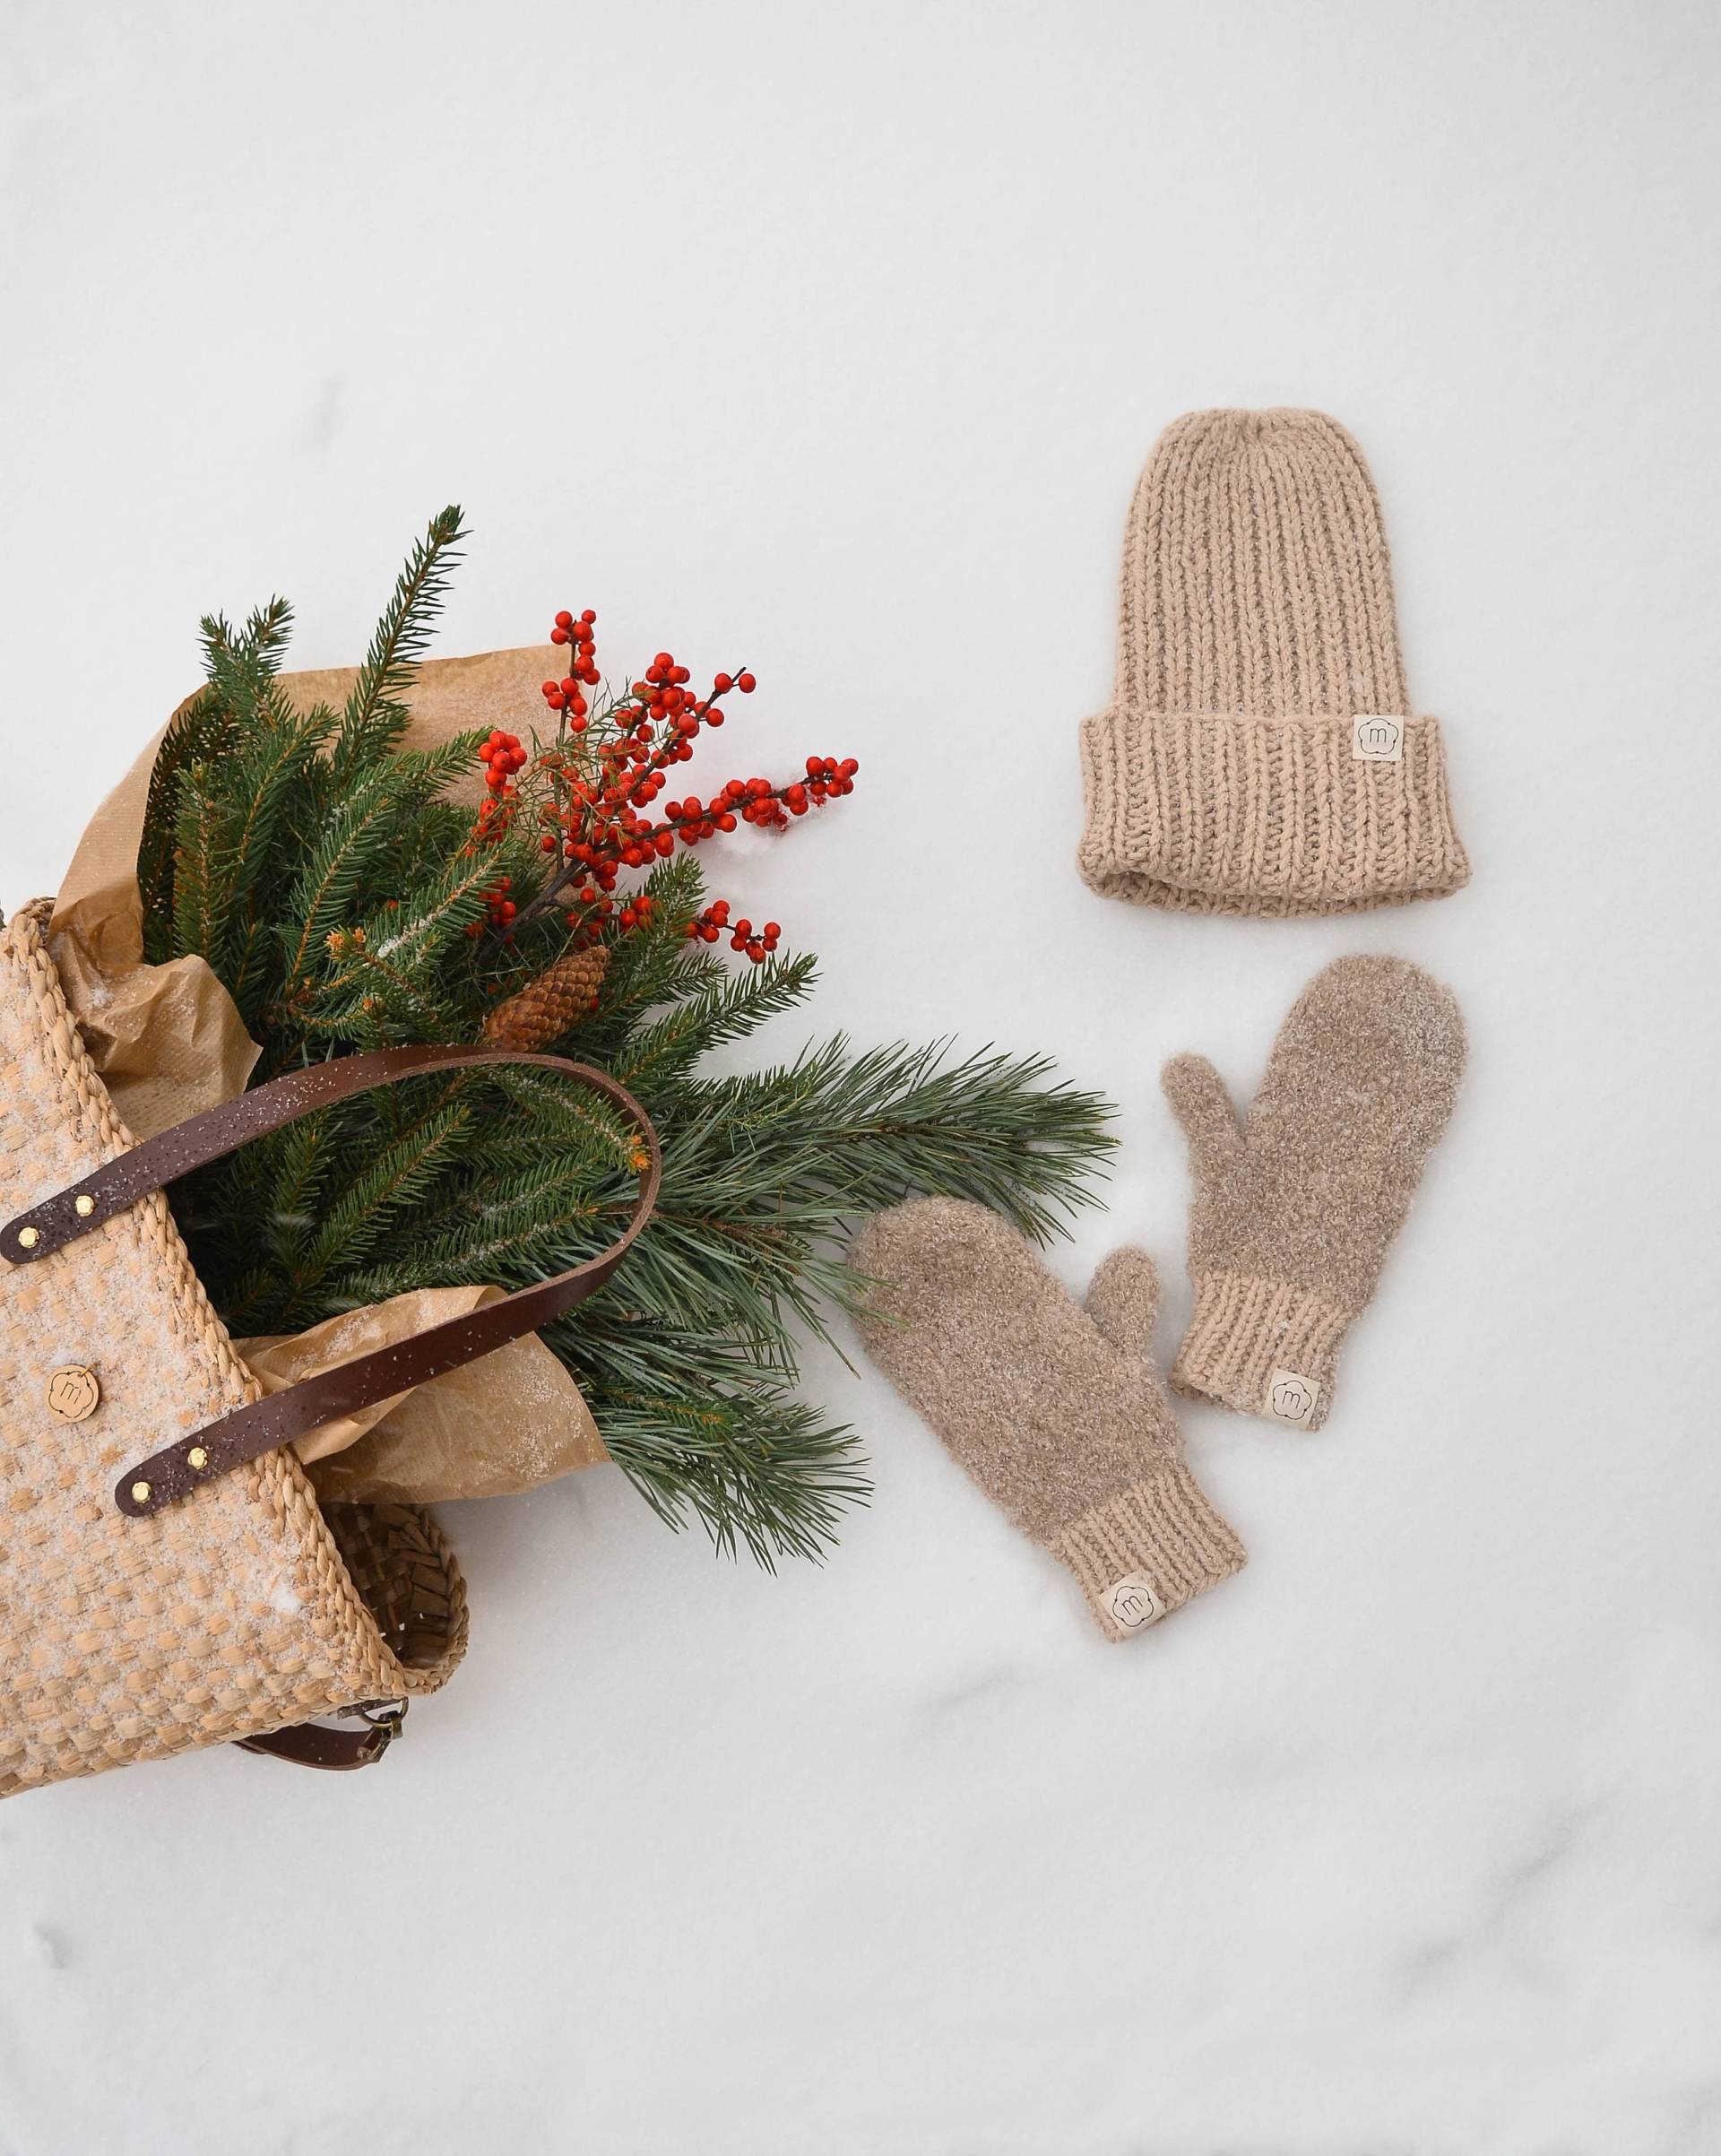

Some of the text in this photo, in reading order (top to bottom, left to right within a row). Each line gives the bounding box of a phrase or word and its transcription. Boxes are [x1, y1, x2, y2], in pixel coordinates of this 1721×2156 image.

[1369, 728, 1387, 743] m
[60, 1381, 82, 1405] m
[1282, 1390, 1301, 1409] m
[1121, 1595, 1144, 1615] m
